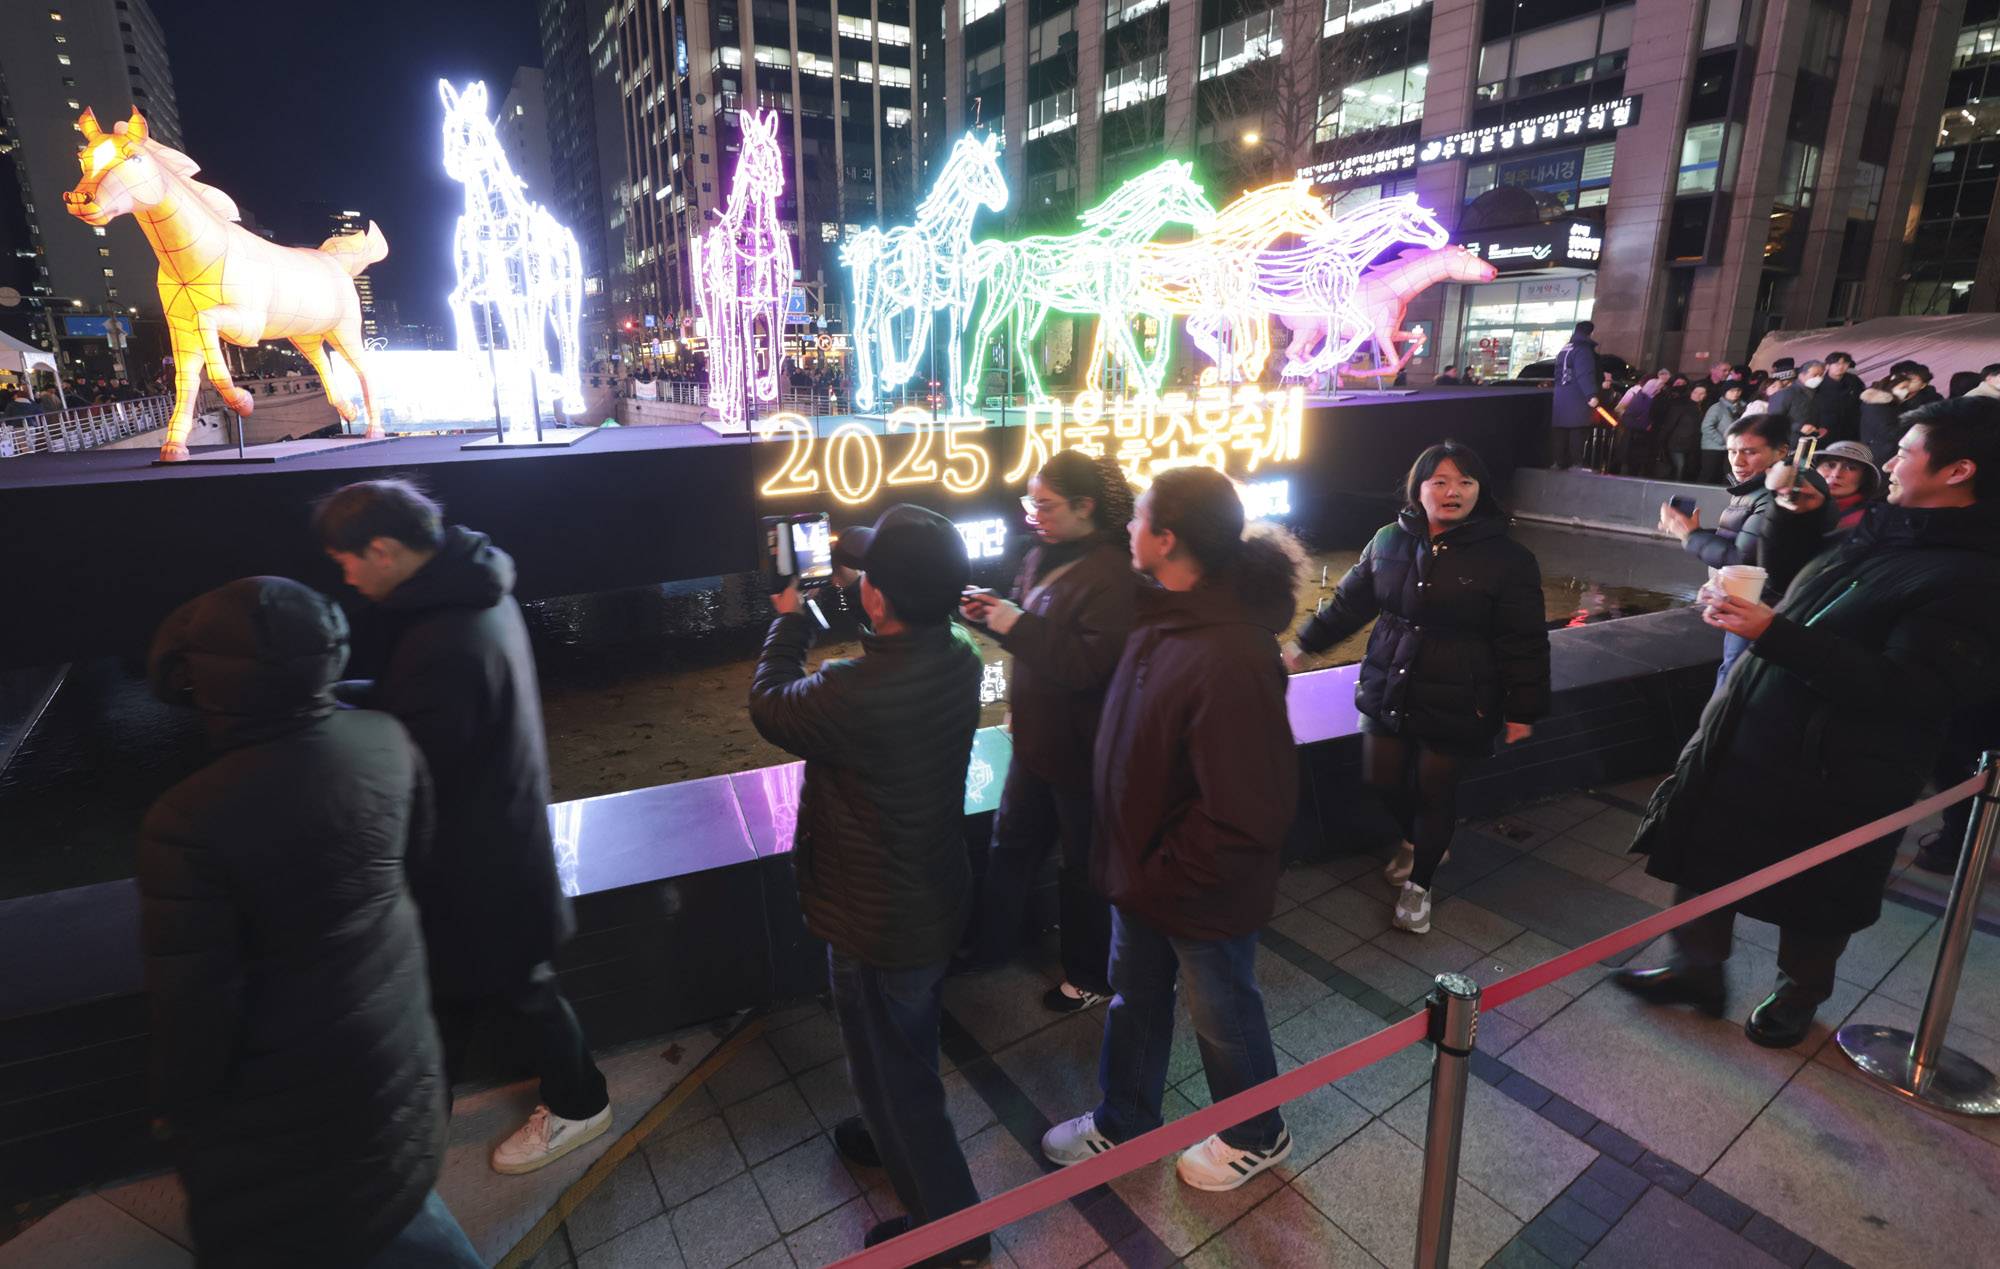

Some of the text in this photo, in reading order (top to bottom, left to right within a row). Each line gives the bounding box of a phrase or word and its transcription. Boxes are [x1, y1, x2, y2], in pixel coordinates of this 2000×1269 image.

[1509, 107, 1586, 131] ORTHOPAEDIC
[1591, 97, 1632, 113] CLINIC
[760, 406, 990, 504] 2025
